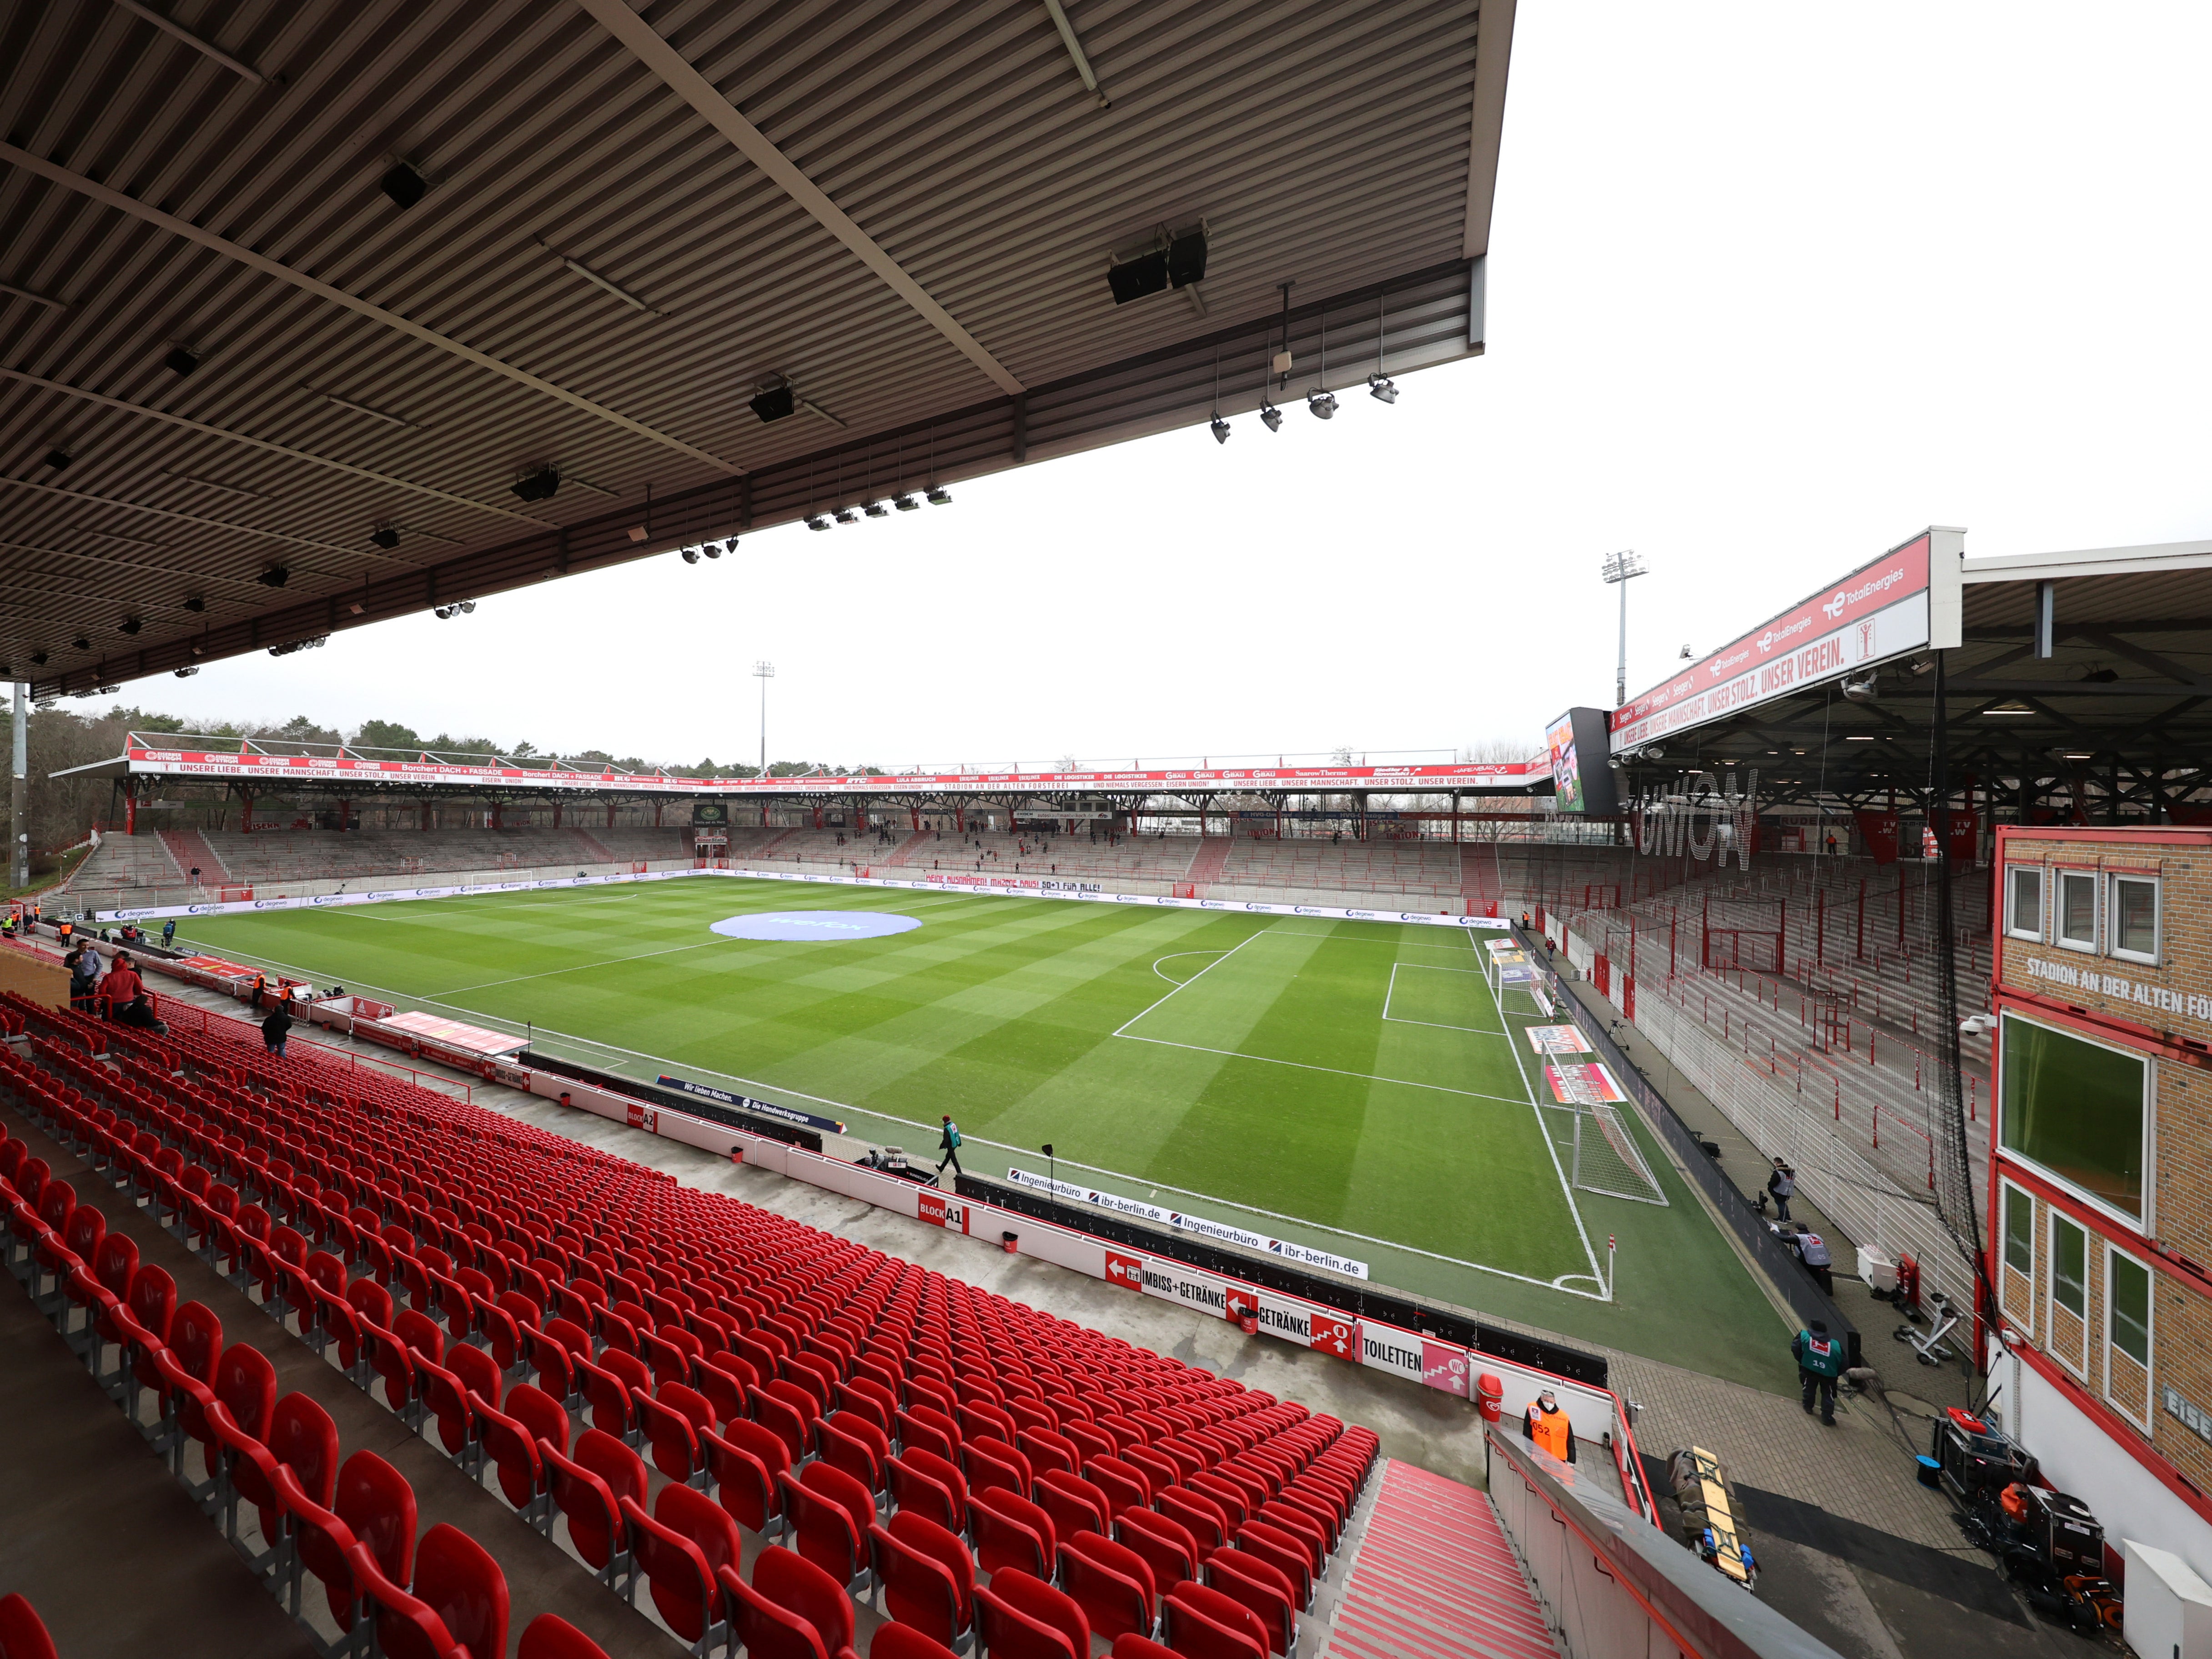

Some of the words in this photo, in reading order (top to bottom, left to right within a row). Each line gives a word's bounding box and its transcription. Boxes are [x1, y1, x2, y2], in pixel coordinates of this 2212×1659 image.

[1846, 568, 1904, 605] TotalEnergies
[1773, 616, 1811, 643] TotalEnergies
[1721, 649, 1749, 670] TotalEnergies
[1624, 726, 1637, 745] UNSERE
[1638, 721, 1649, 739] LIEBE.
[1650, 714, 1667, 735] UNSERE
[1669, 697, 1706, 729] MANNSCHAFT.
[1708, 686, 1730, 714] UNSER
[1731, 675, 1757, 705] STOLZ.
[1762, 658, 1793, 694] UNSER
[1797, 637, 1845, 679] VEREIN.
[1673, 681, 1689, 697] Seeger
[1635, 703, 1647, 716] Seeger
[1652, 694, 1666, 708] Seeger
[1619, 710, 1631, 724] Seeger
[180, 764, 217, 773] UNSERE
[218, 765, 244, 774] LIEBE.
[248, 766, 280, 774] UNSERE
[283, 768, 336, 777] MANNSCHAFT.
[402, 764, 437, 773] Borchert
[1453, 765, 1495, 774] HAFENBAR
[1639, 769, 1758, 871] UNION
[926, 874, 944, 883] KEINE
[947, 875, 987, 886] AUSNAHMEN!
[1020, 880, 1039, 888] RAUS!
[1080, 883, 1100, 892] ALLE!
[128, 910, 155, 918] degewo
[1469, 918, 1492, 926] degewo
[768, 917, 870, 931] wefox
[2027, 957, 2077, 987] STADION
[2080, 970, 2099, 992] AN
[2102, 975, 2130, 1000] DER
[2132, 983, 2182, 1014] ALTEN
[2187, 993, 2212, 1021] FÖ
[684, 1082, 694, 1091] Wir
[694, 1085, 710, 1096] lieben
[710, 1090, 732, 1102] Machen.
[628, 1111, 643, 1123] BLOCK
[643, 1113, 653, 1126] A2
[760, 1104, 809, 1123] Handwerksgruppe
[909, 1172, 929, 1182] BUNDESLIGA
[1021, 1173, 1081, 1197] Ingenieurbüro
[920, 1203, 945, 1219] BLOCK
[945, 1207, 962, 1224] A1
[1101, 1195, 1160, 1219] ibr-berlin.de
[1184, 1217, 1258, 1246] Ingenieurbüro
[1285, 1245, 1359, 1275] ibr-berlin.de
[1142, 1269, 1226, 1310] IMBISS+GETRÄNKE
[1259, 1307, 1310, 1338] GETRÄNKE
[1363, 1338, 1422, 1372] TOILETTEN
[1813, 1359, 1825, 1369] 19
[1452, 1361, 1462, 1373] WC
[1533, 1421, 1550, 1436] 052
